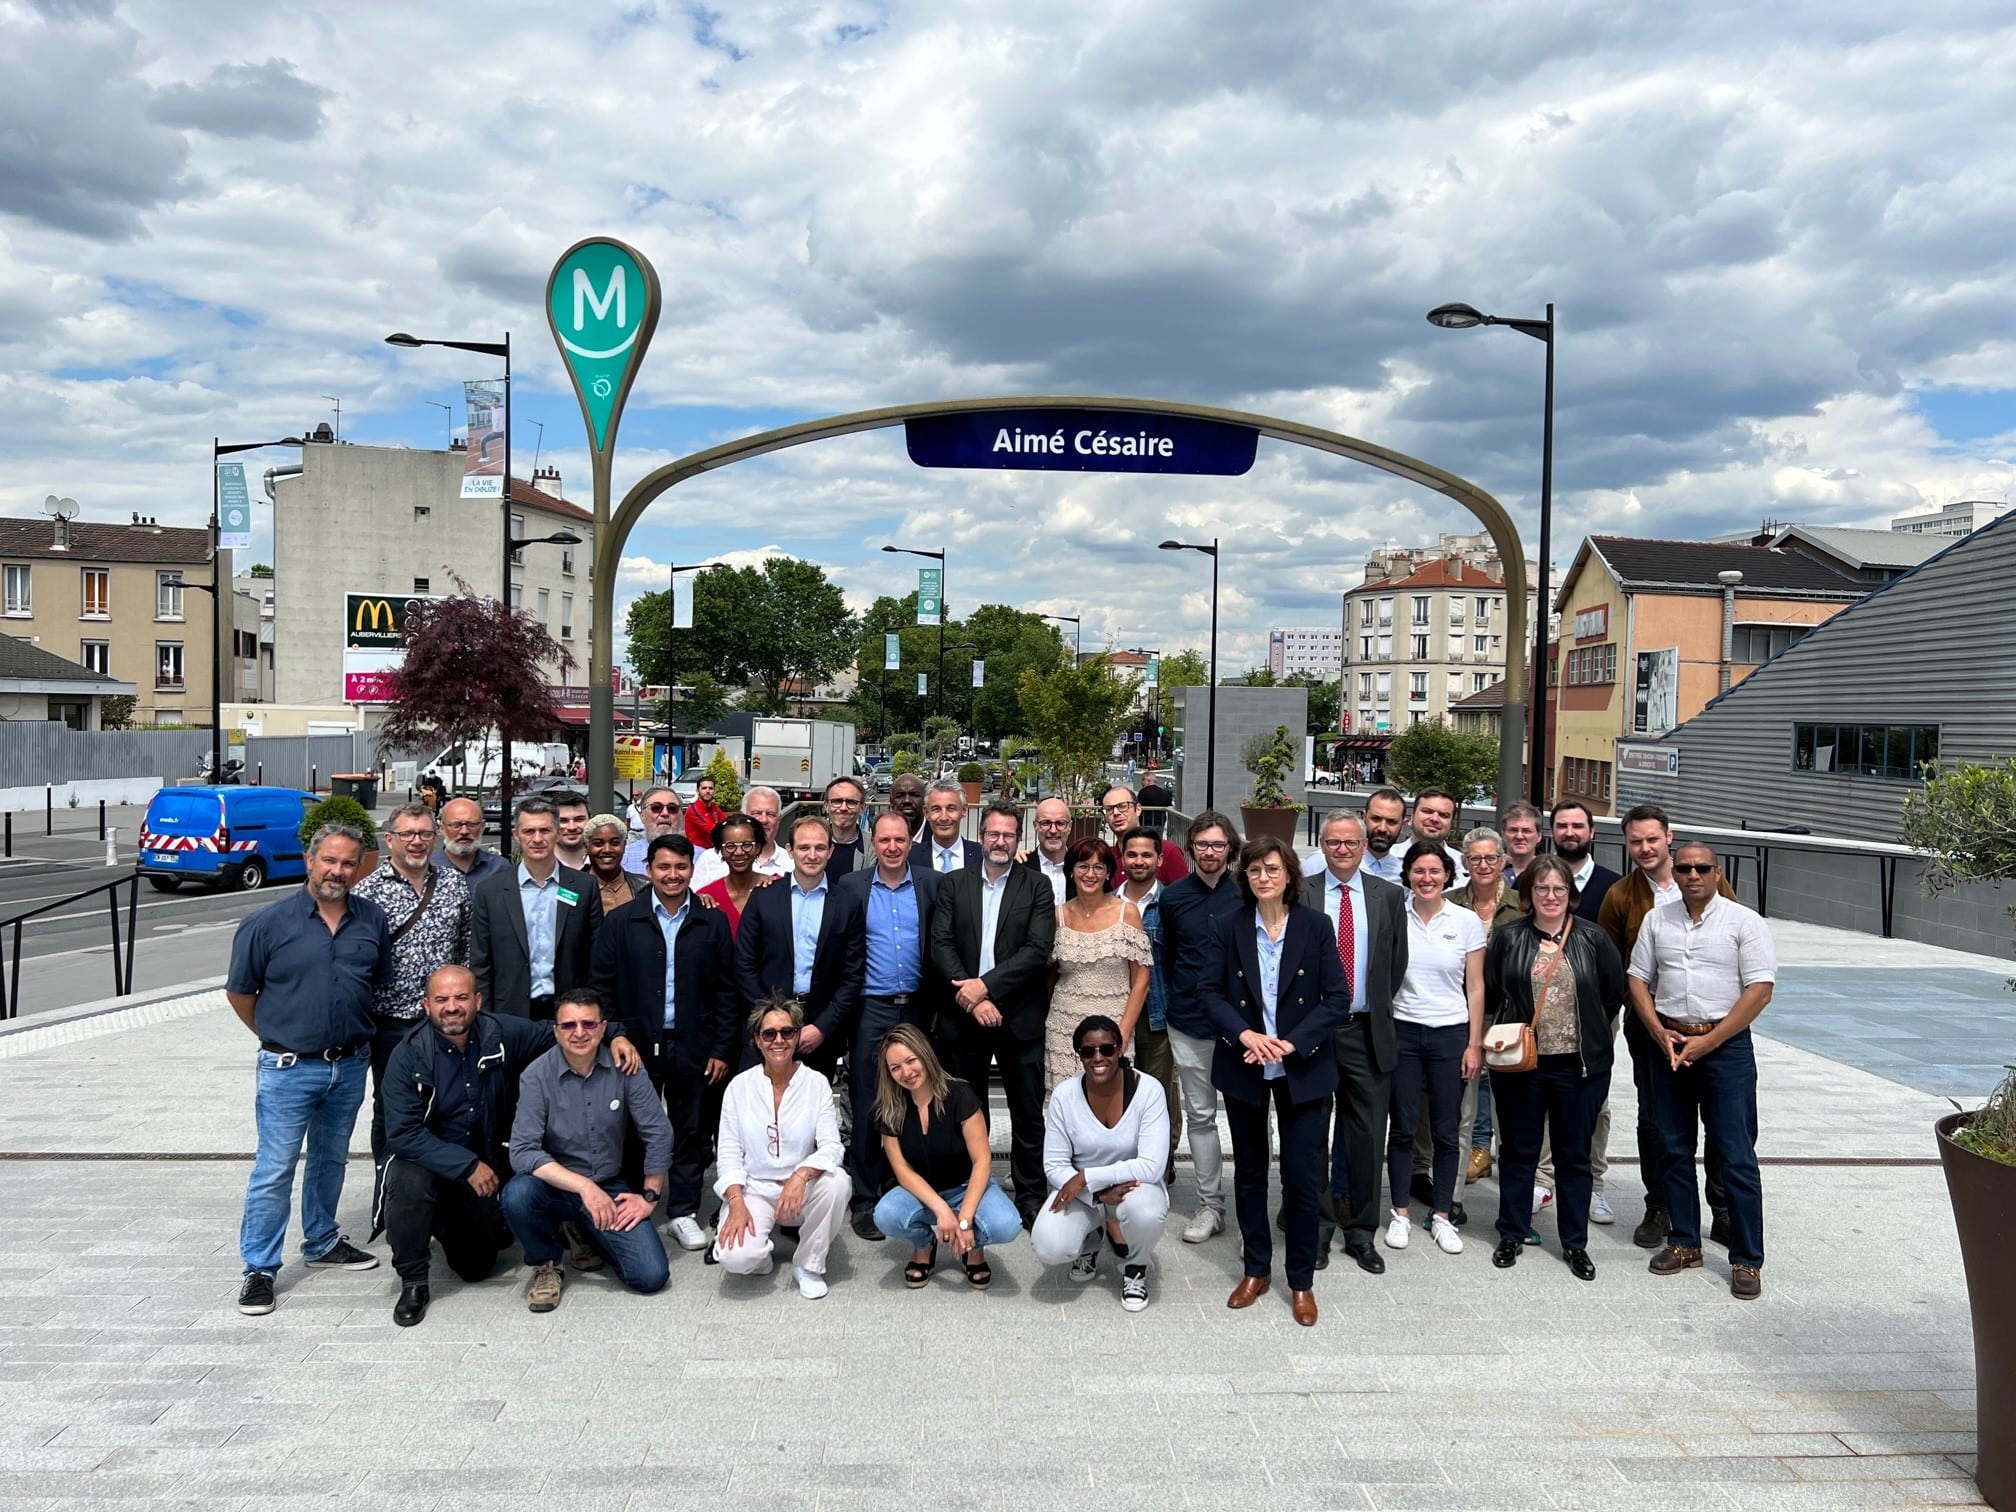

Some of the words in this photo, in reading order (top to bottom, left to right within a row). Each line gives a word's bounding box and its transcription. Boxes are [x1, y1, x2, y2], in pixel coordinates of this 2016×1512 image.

[573, 265, 626, 331] M
[992, 427, 1065, 454] Aimé
[1074, 430, 1174, 457] Césaire
[360, 675, 366, 683] 2
